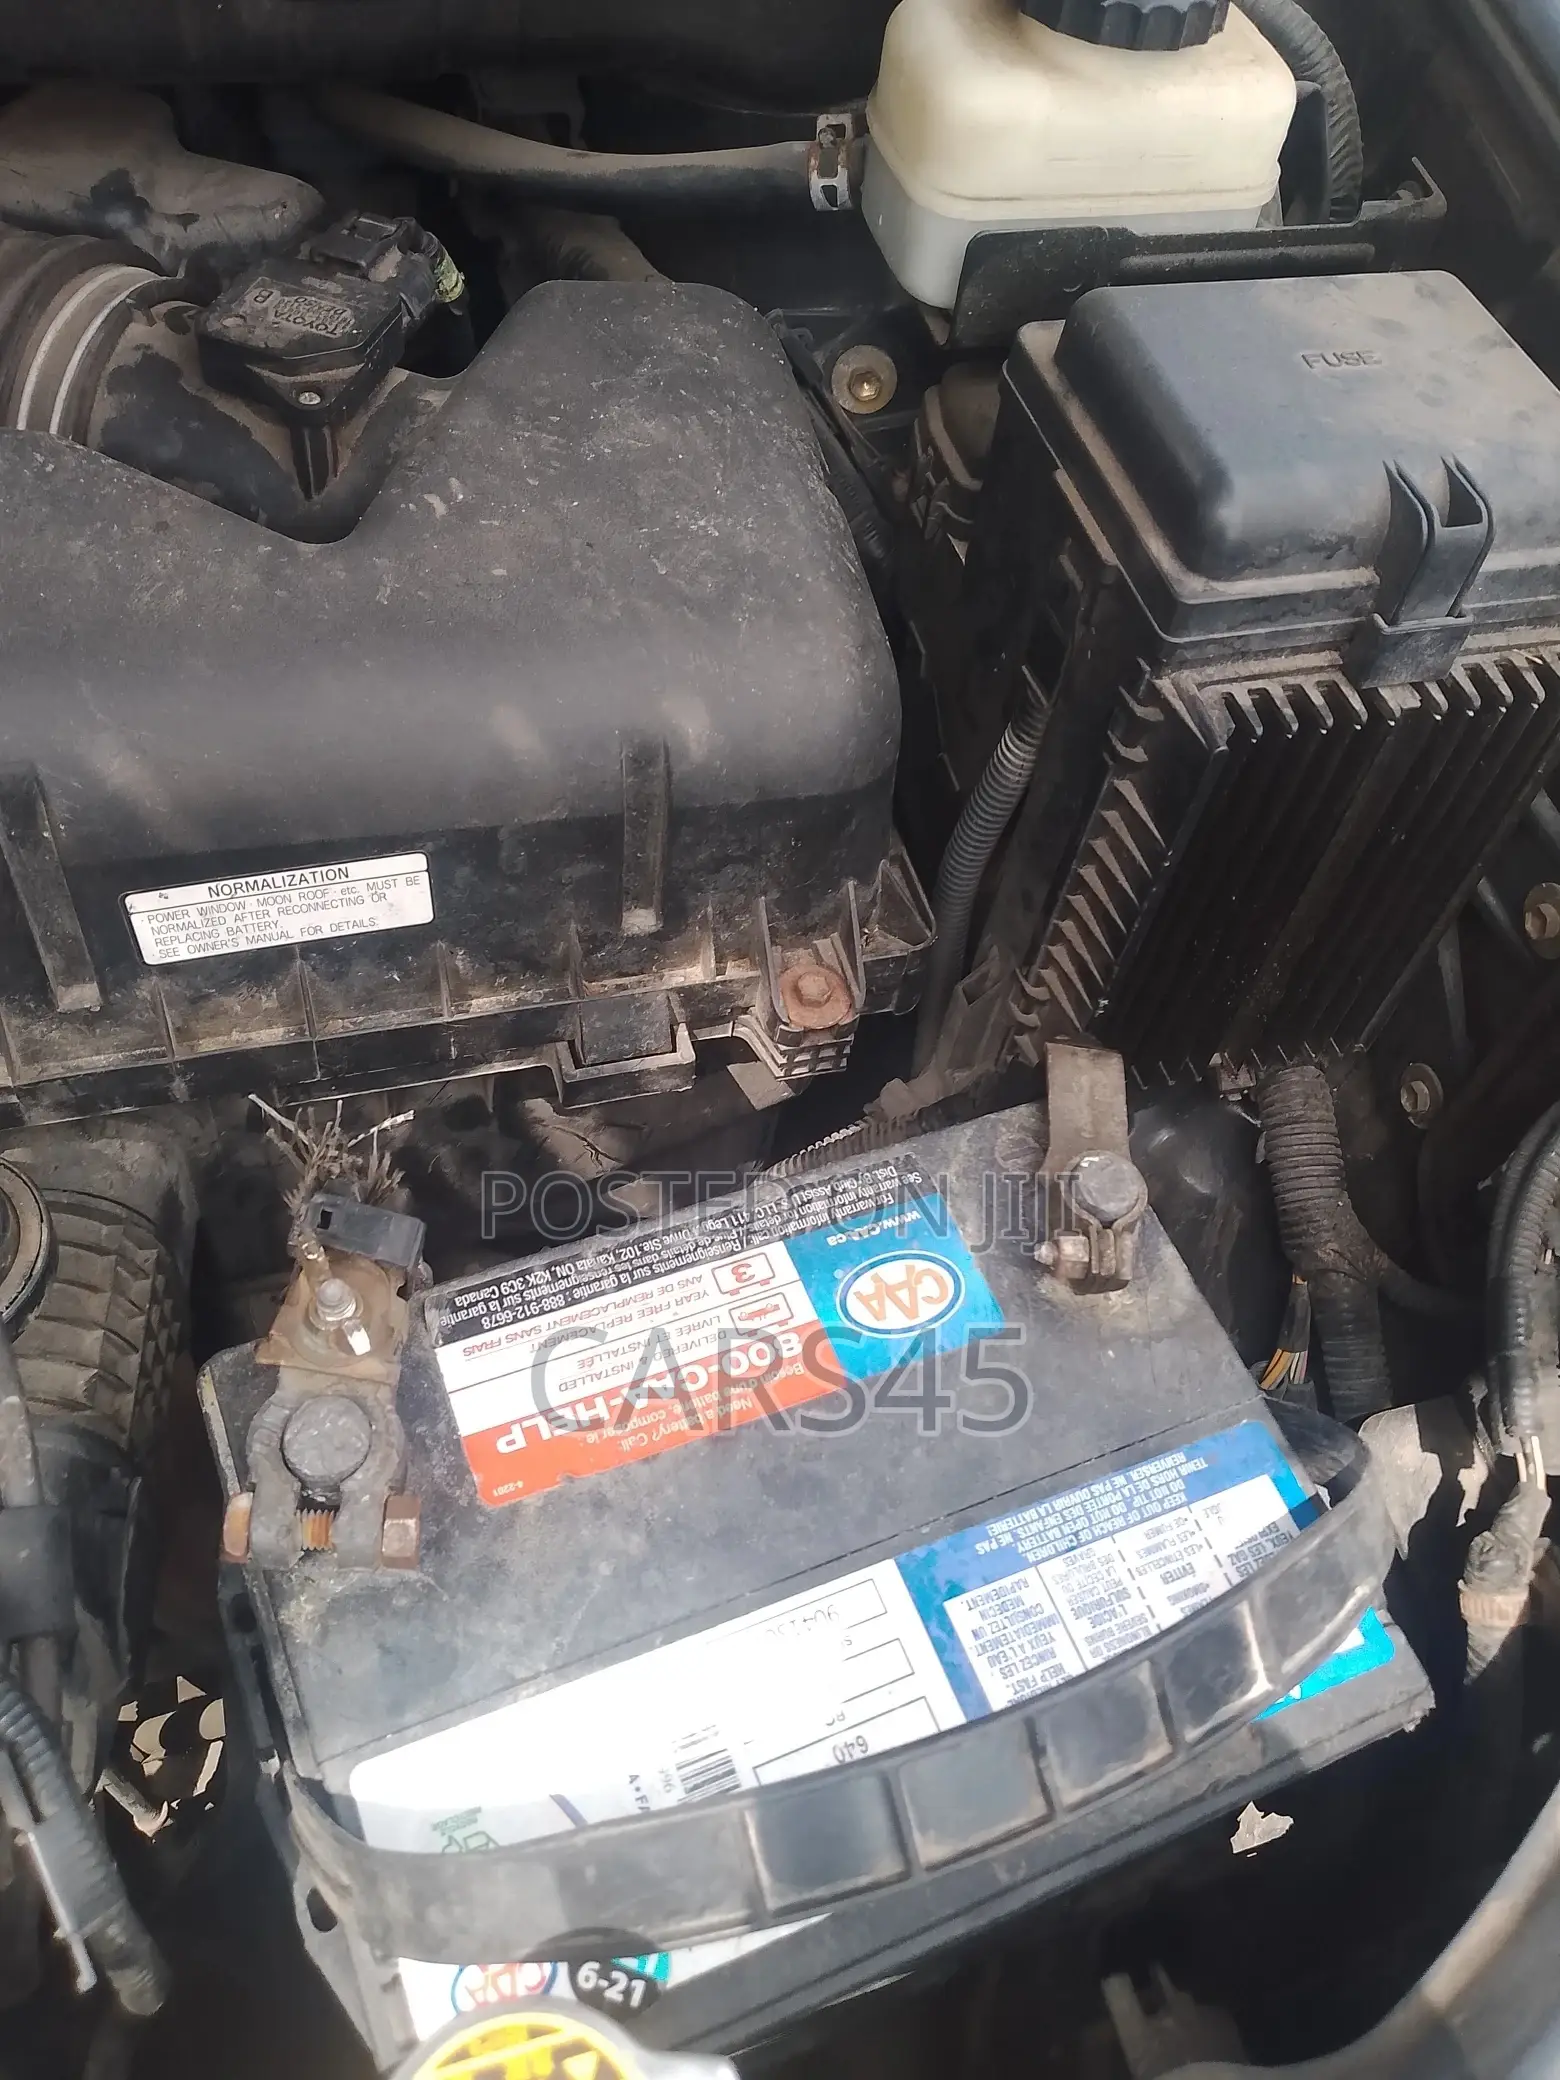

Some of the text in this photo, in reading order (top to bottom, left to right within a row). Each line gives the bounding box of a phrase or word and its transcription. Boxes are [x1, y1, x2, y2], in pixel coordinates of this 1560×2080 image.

[254, 289, 273, 304] B
[272, 309, 338, 335] TOYOTA
[1301, 350, 1383, 370] FUSE
[207, 865, 349, 899] NORMALIZATION
[146, 875, 420, 924] POWER WINDOW MOON ROOF etc. MUST BE
[151, 891, 387, 936] NORMALIZED AFTER RECONNECTING OR
[154, 918, 283, 947] REPLACING BATTERY.
[158, 916, 378, 959] SEE OWNER'S MANUAL FOR DETAILS.
[871, 1164, 896, 1182] Dist.
[900, 1170, 922, 1187] See
[799, 1184, 833, 1204] Assist
[832, 1177, 857, 1194] Club
[855, 1174, 901, 1200] warranty
[797, 1190, 857, 1217] information
[730, 1209, 751, 1226] 411
[781, 1208, 798, 1222] for
[613, 1235, 662, 1261] Ste.102,
[660, 1240, 696, 1260] détails
[479, 1191, 893, 1330] For warranty information call: Renseignements sur la garantie 888-912-6678
[551, 1260, 575, 1280] ON,
[630, 1250, 660, 1269] dans
[520, 1262, 614, 1303] renseignements
[523, 1268, 552, 1289] K2K
[729, 1261, 756, 1284] 3
[453, 1284, 500, 1310] Canada
[498, 1276, 526, 1296] 3C9
[855, 1264, 949, 1321] CAA
[486, 1298, 501, 1313] la
[499, 1292, 522, 1309] sur
[437, 1300, 488, 1329] garantie
[461, 1273, 703, 1357] ANS DE REMPLACEMENT SANS FRAIS
[526, 1288, 708, 1353] YEAR FREE REPLACEMENT
[575, 1314, 722, 1371] LIVRÉE ET INSTALLÉE
[651, 1329, 727, 1361] DELIVERED
[557, 1360, 636, 1392] INSTALLED
[490, 1328, 804, 1456] 800-CAA-HELP
[715, 1395, 753, 1418] Need
[598, 1406, 667, 1440] composer
[648, 1411, 704, 1441] battery?
[614, 1430, 649, 1453] Call:
[1149, 1466, 1179, 1488] HORS
[1177, 1455, 1208, 1477] TENIR
[1089, 1478, 1113, 1497] PAS
[1111, 1473, 1128, 1489] NE
[1120, 1482, 1136, 1498] LA
[1133, 1477, 1151, 1493] DE
[1169, 1478, 1185, 1492] DO
[1051, 1486, 1092, 1513] OUVRIR
[1146, 1484, 1171, 1502] NOT
[1160, 1489, 1188, 1509] KEEP
[1035, 1501, 1053, 1517] LA
[1060, 1502, 1084, 1521] DES
[1088, 1506, 1111, 1524] NOT
[1109, 1500, 1127, 1516] DO
[1124, 1508, 1140, 1523] OF
[1139, 1500, 1162, 1517] OUT
[984, 1505, 1039, 1538] BATTERIE!
[1059, 1514, 1090, 1536] OPEN
[1090, 1513, 1126, 1537] REACH
[996, 1530, 1014, 1547] NE
[1075, 1526, 1093, 1542] OF
[1175, 1529, 1192, 1543] LES
[973, 1536, 998, 1556] PAS
[1182, 1542, 1200, 1557] LES
[1246, 1540, 1267, 1558] LES
[1226, 1548, 1249, 1567] GAZ
[1158, 1561, 1197, 1589] ÉVITER
[1234, 1560, 1255, 1578] LES
[978, 1593, 1024, 1622] MEDECIN
[1069, 1585, 1131, 1621] SULFURIQUE
[970, 1601, 1044, 1641] CONSULTEZ UN
[1026, 1629, 1055, 1651] YEUX
[985, 1645, 1018, 1668] L'EAU
[998, 1661, 1019, 1679] LES
[1036, 1661, 1066, 1684] HELP
[829, 1733, 871, 1765] 640
[576, 1959, 647, 2009] 6-21
